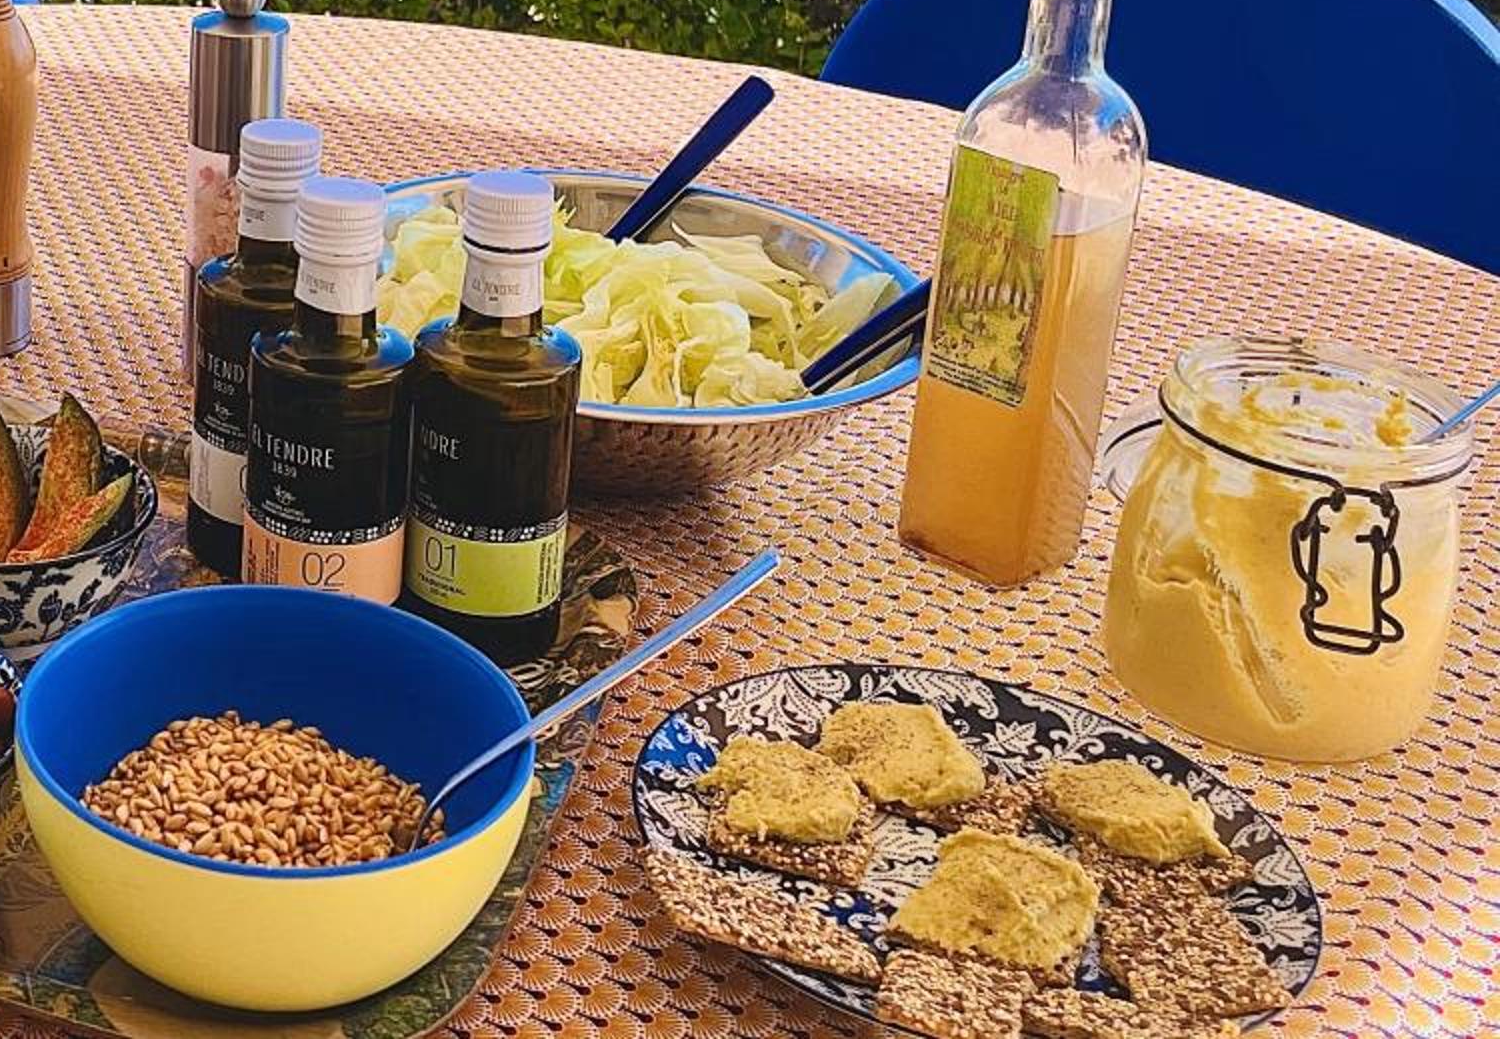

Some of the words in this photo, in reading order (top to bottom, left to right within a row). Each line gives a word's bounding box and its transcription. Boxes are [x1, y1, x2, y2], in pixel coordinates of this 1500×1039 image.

[207, 352, 245, 384] TEND
[266, 432, 336, 471] TENDRE
[420, 424, 461, 460] NDRE
[273, 461, 297, 478] 1839
[301, 551, 346, 587] 02
[425, 536, 457, 578] 01
